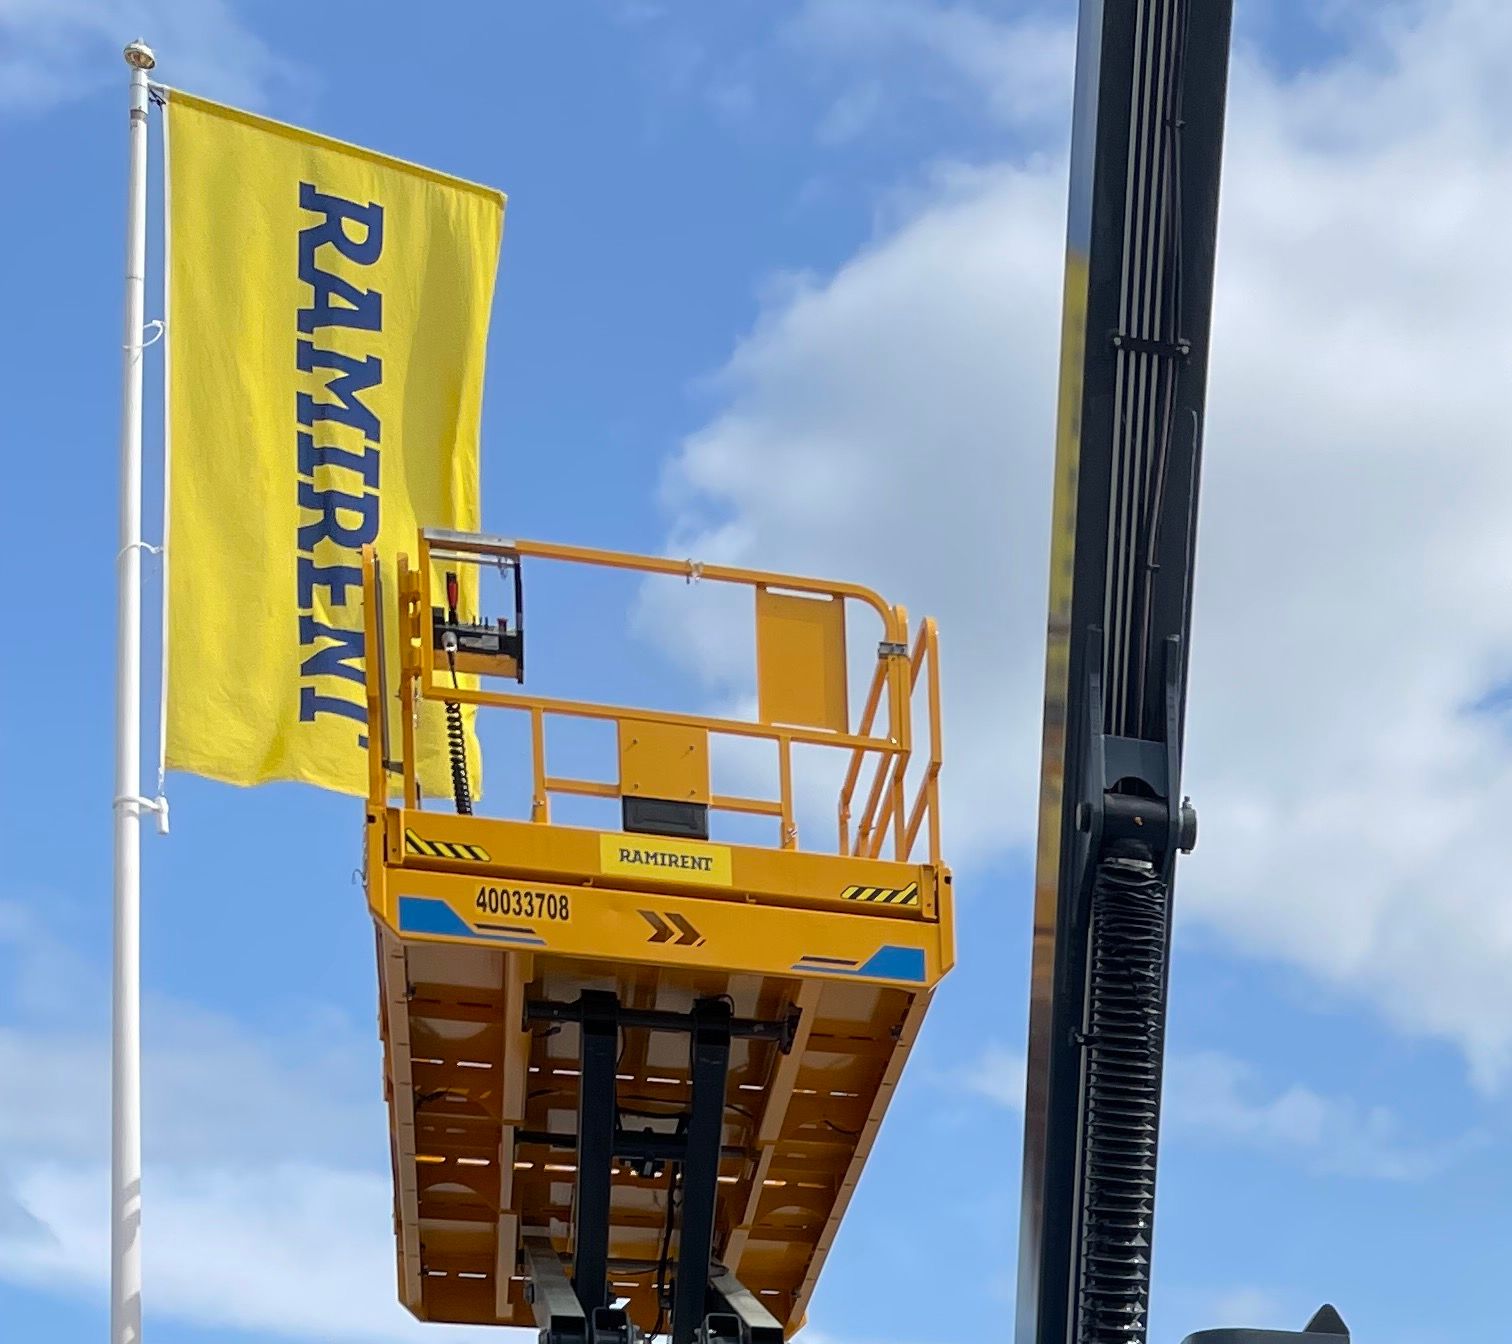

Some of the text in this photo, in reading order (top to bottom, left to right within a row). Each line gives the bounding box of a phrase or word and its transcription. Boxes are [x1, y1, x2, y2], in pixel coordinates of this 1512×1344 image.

[297, 182, 385, 749] RAMIRENT
[618, 847, 713, 871] RAMIRENT
[475, 885, 570, 921] 40033708
